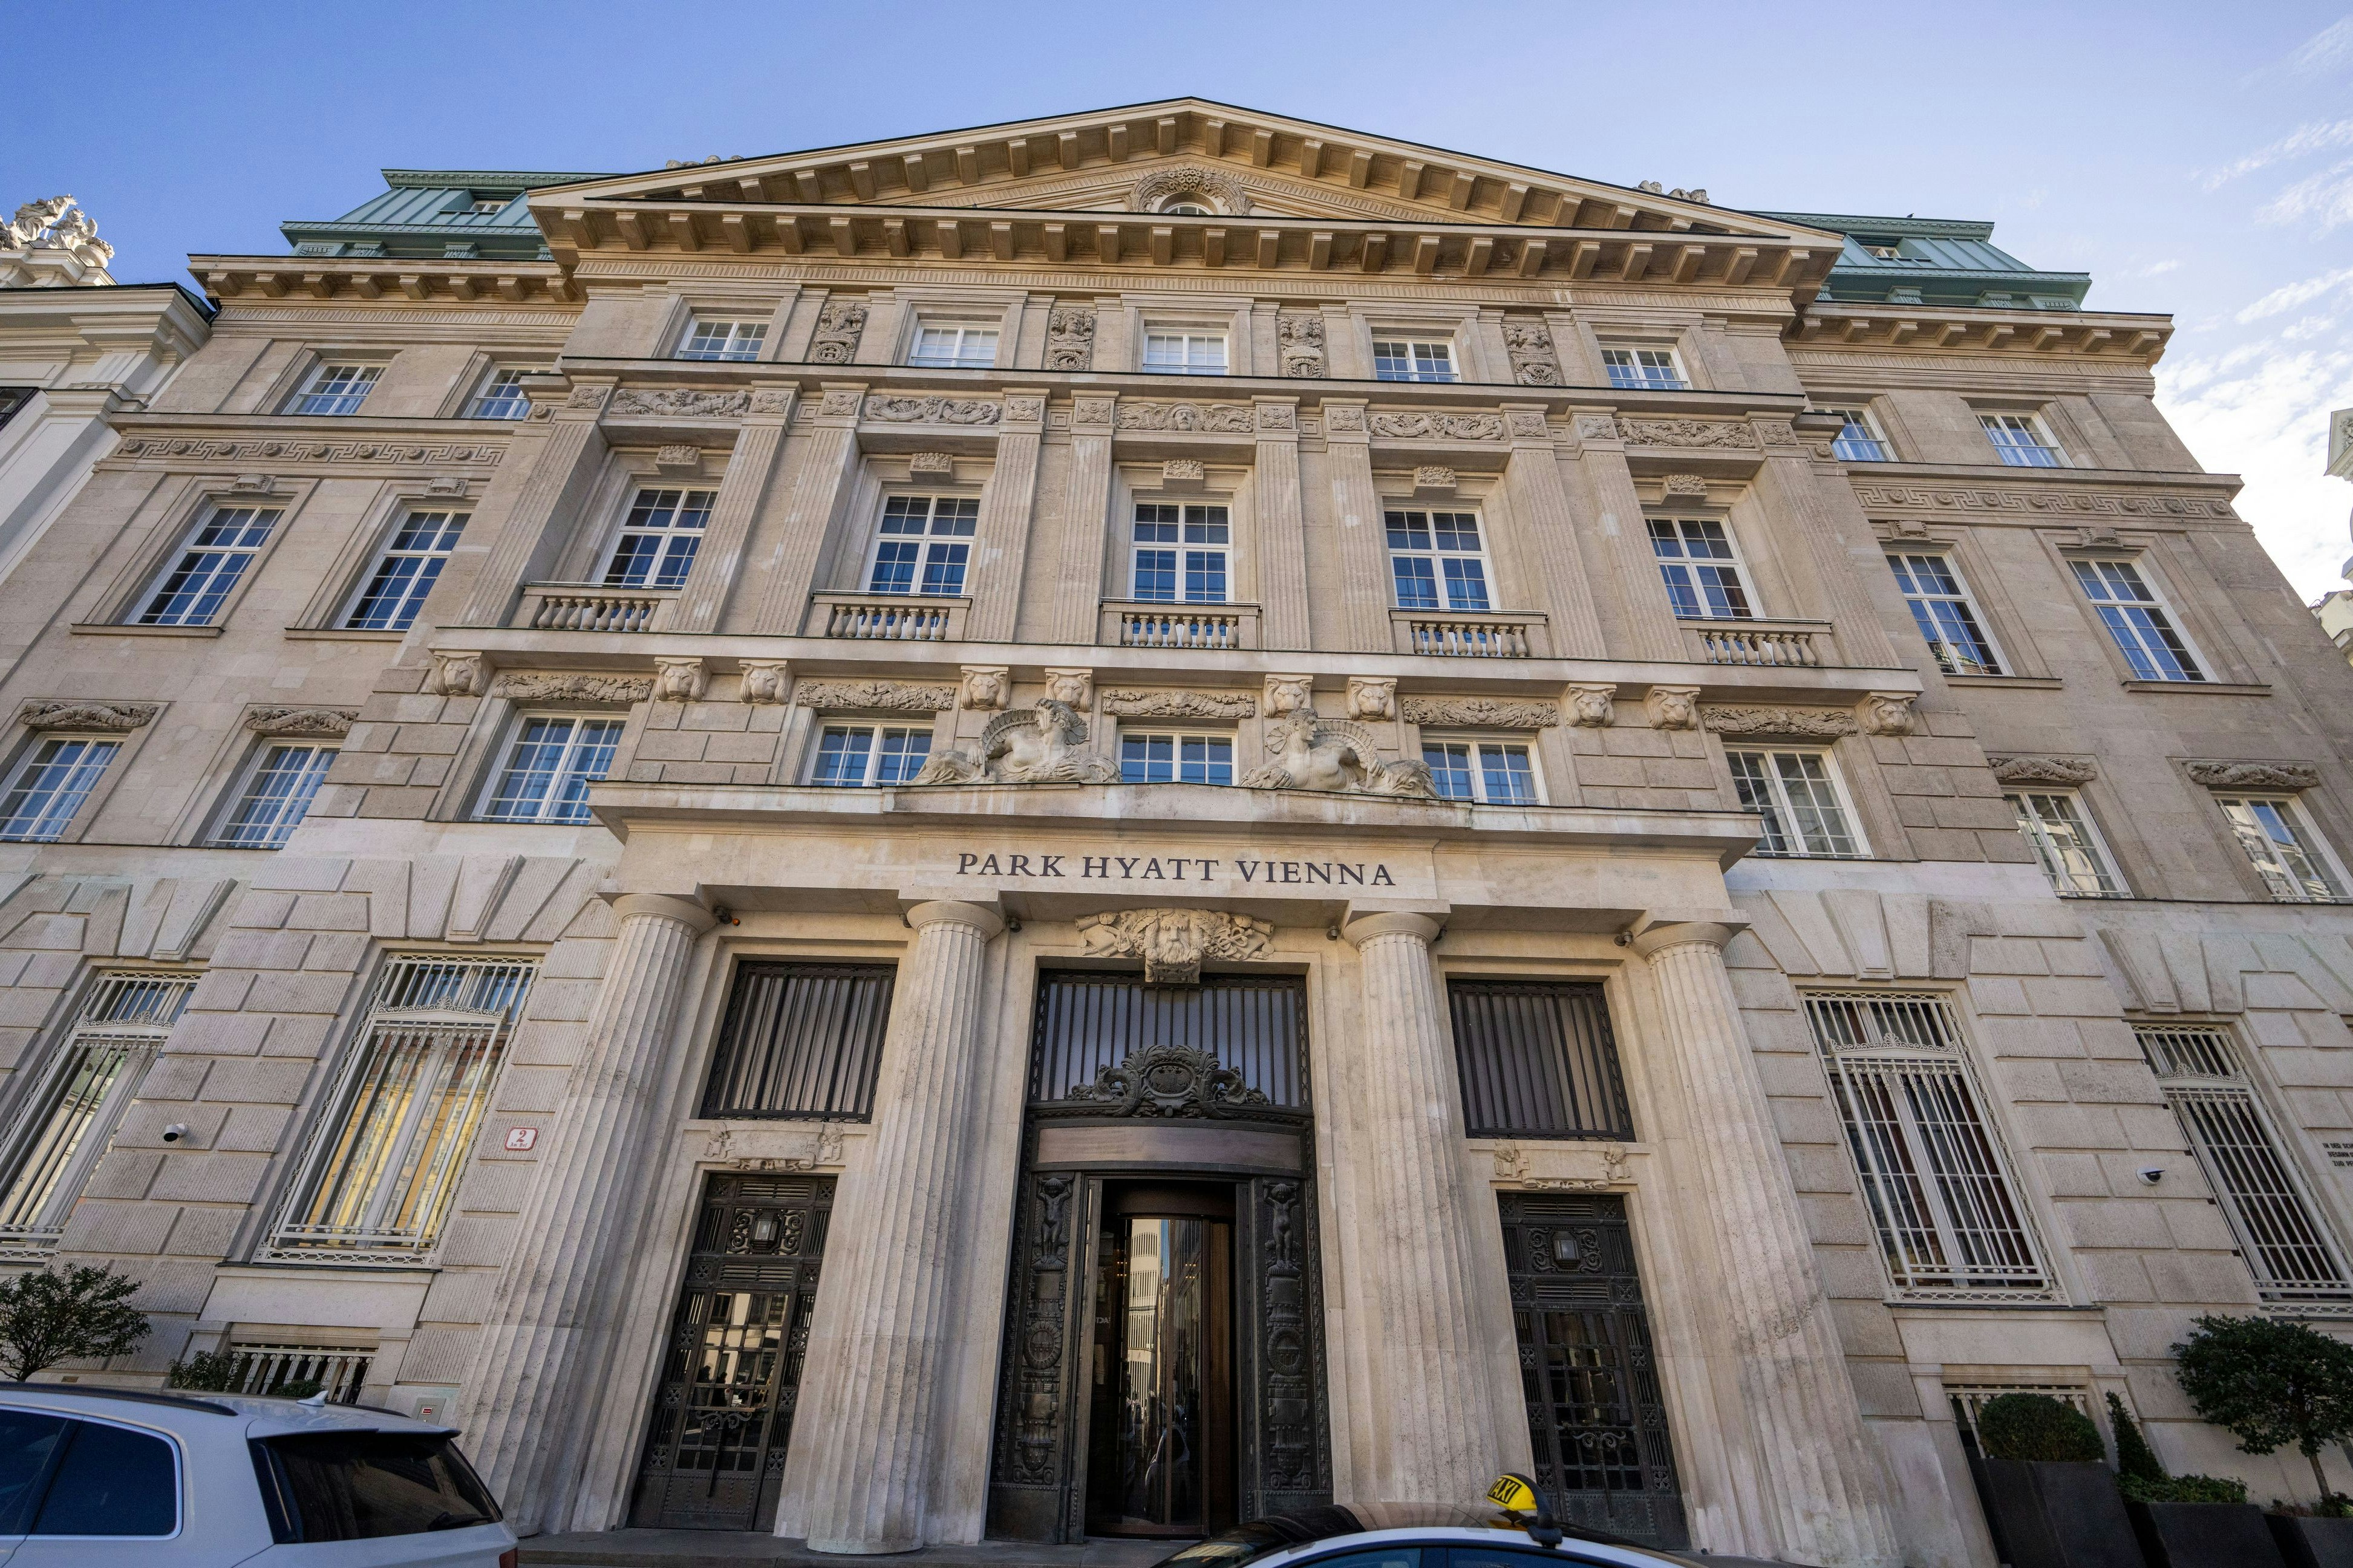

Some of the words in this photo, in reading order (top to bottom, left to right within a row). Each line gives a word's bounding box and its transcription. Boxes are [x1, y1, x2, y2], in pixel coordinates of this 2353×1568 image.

[956, 854, 1066, 877] PARK
[1082, 857, 1219, 881] HYATT
[1235, 860, 1395, 886] VIENNA
[516, 1130, 527, 1142] 2
[1489, 1479, 1518, 1503] TAXI
